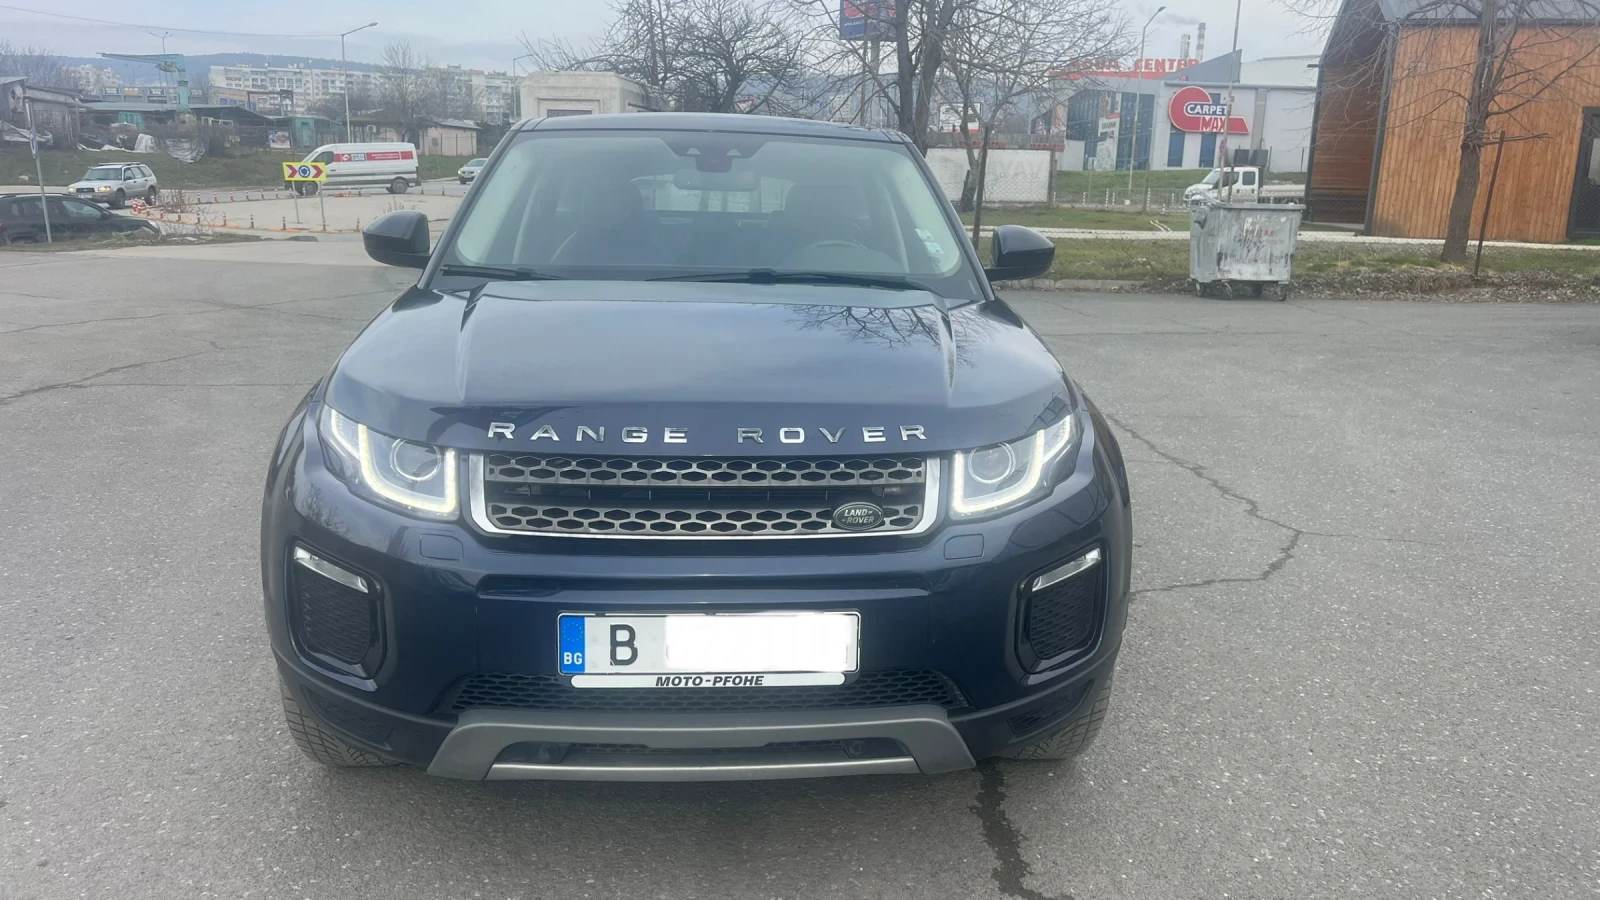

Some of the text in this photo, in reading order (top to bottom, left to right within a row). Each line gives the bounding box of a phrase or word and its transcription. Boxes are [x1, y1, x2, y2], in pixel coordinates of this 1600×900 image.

[1187, 104, 1228, 115] CARPET
[1201, 116, 1227, 132] MAX
[487, 421, 928, 444] RANGE ROVER
[844, 508, 868, 517] LAND
[846, 516, 875, 524] ROVER
[609, 623, 639, 667] B
[563, 652, 583, 665] BG
[655, 675, 764, 687] MOTO-PFOHE
